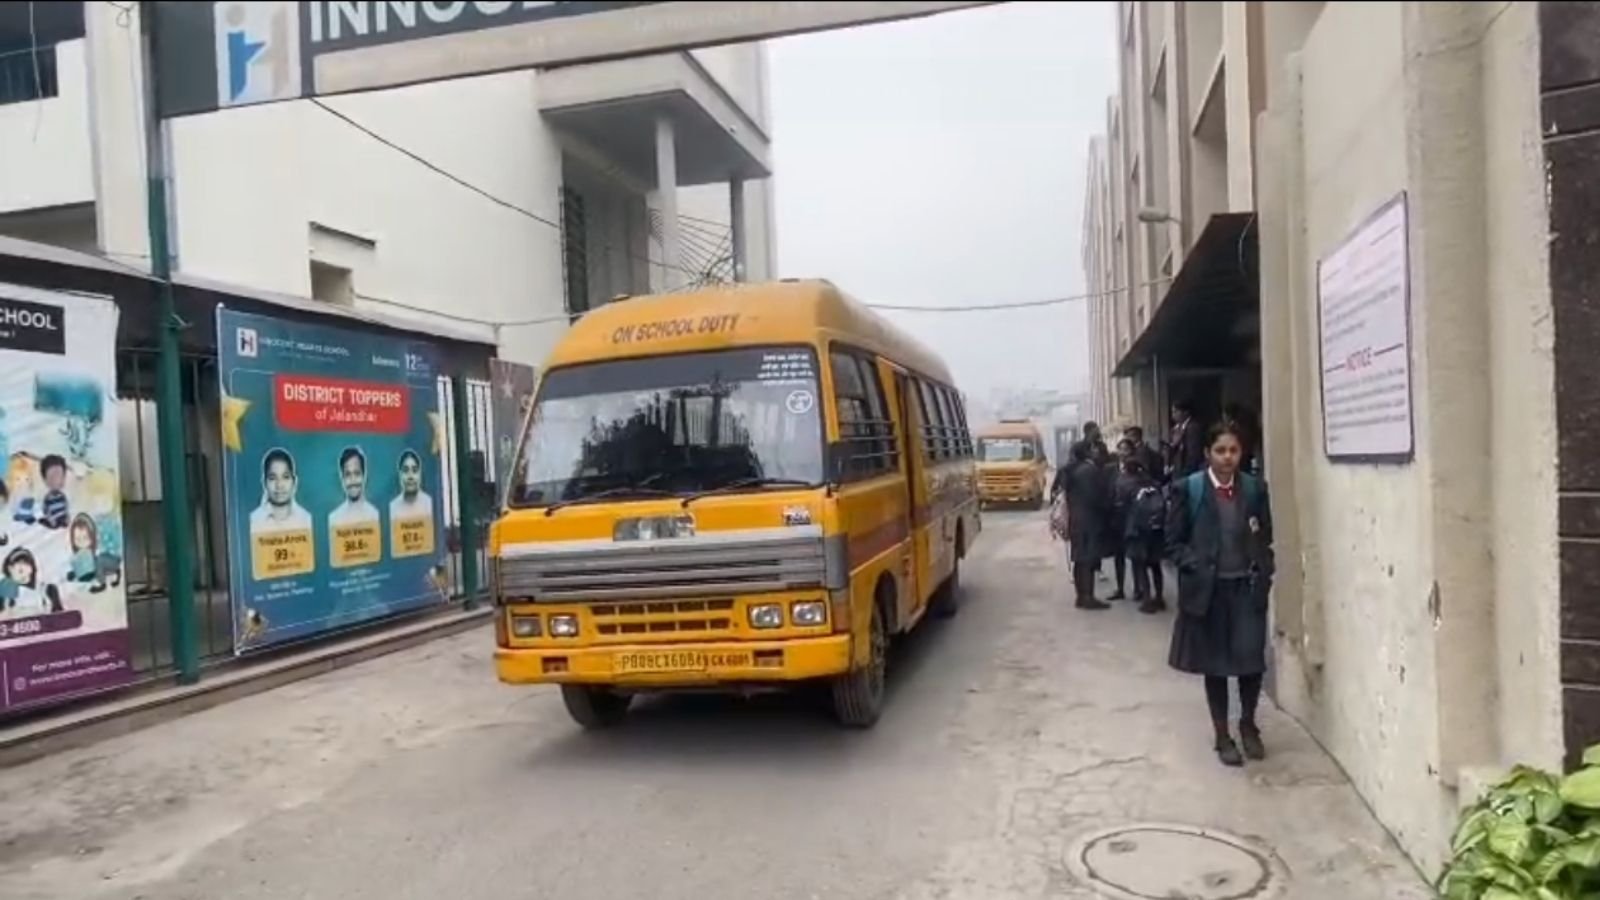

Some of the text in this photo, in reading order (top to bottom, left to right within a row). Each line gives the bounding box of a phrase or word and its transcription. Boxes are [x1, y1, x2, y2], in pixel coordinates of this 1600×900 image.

[0, 308, 58, 330] HOOL
[612, 314, 741, 344] ON SCHOOL DUTY
[1346, 346, 1372, 371] NOTICE
[283, 383, 402, 408] DISTRICT TOPPERS
[315, 409, 378, 423] of Jalandhar
[49, 658, 72, 670] more
